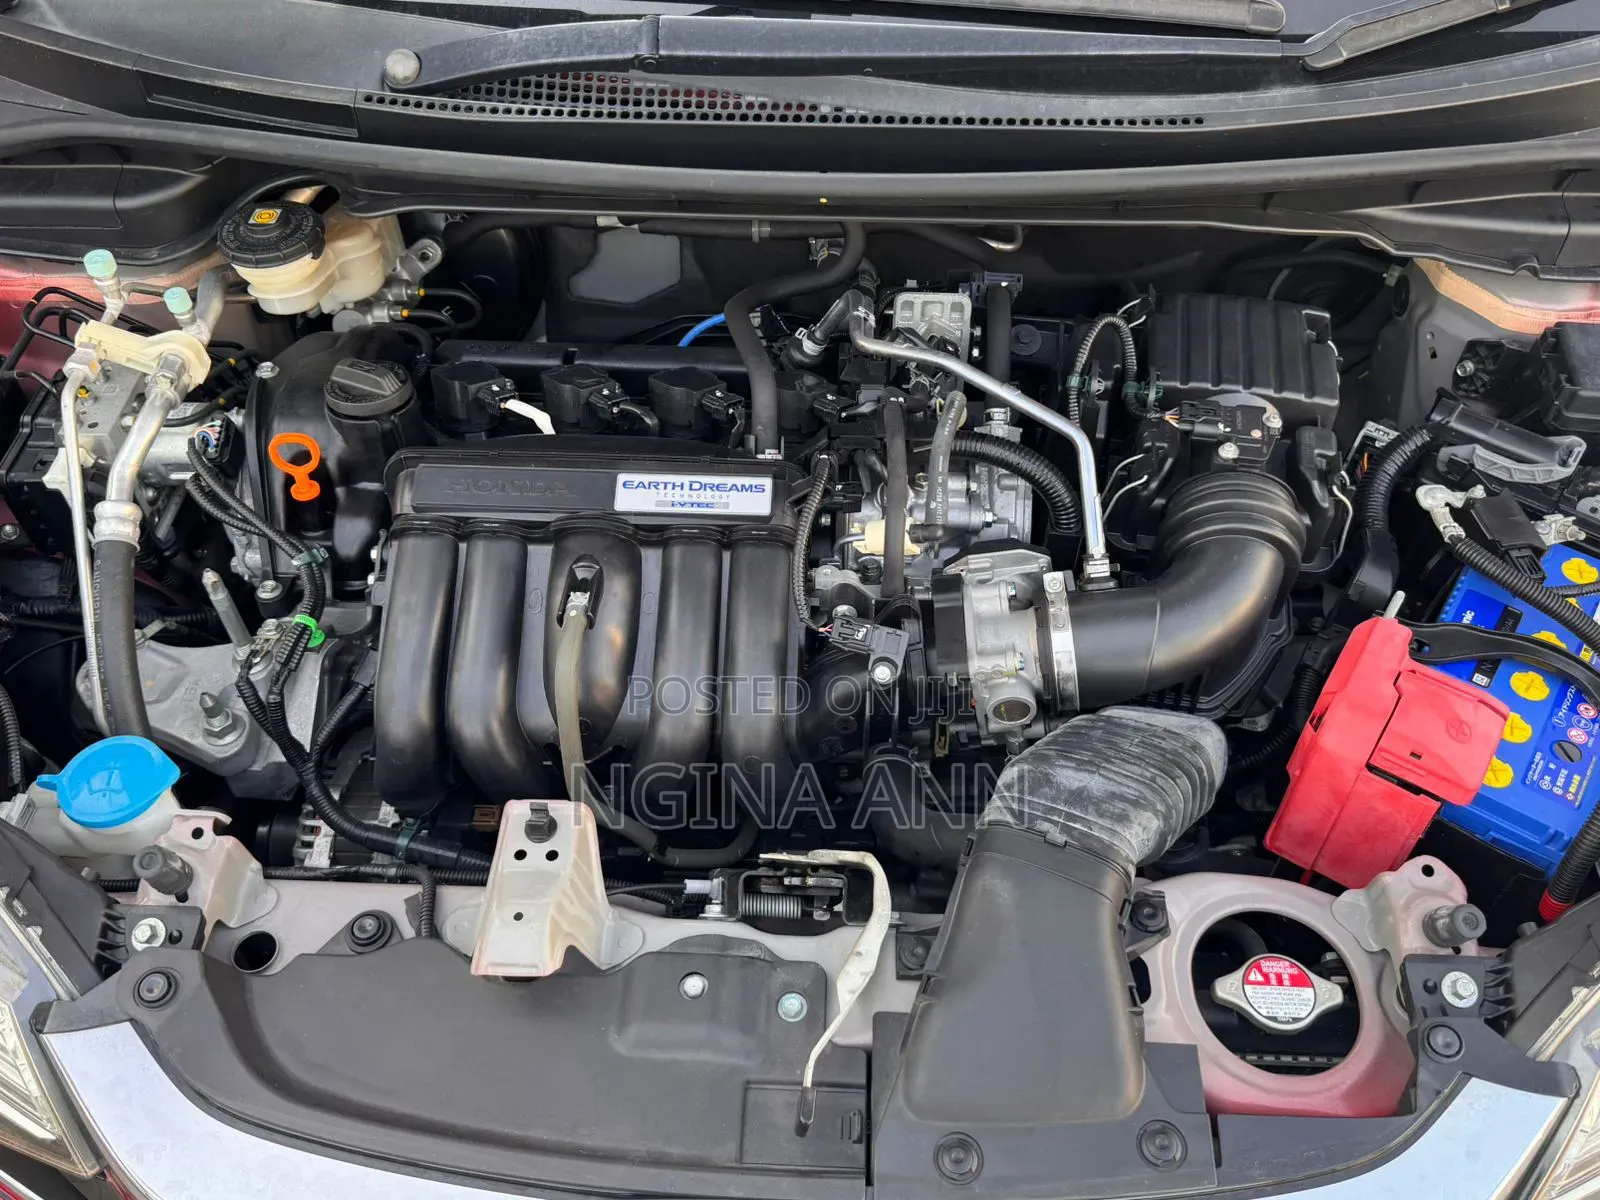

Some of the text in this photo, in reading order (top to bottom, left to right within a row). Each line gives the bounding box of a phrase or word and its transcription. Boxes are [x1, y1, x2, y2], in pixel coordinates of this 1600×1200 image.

[442, 478, 577, 497] HONDA
[622, 480, 766, 493] EARTH DREAMS
[656, 492, 731, 500] TECHNOLOGY
[1260, 960, 1290, 968] DANGER
